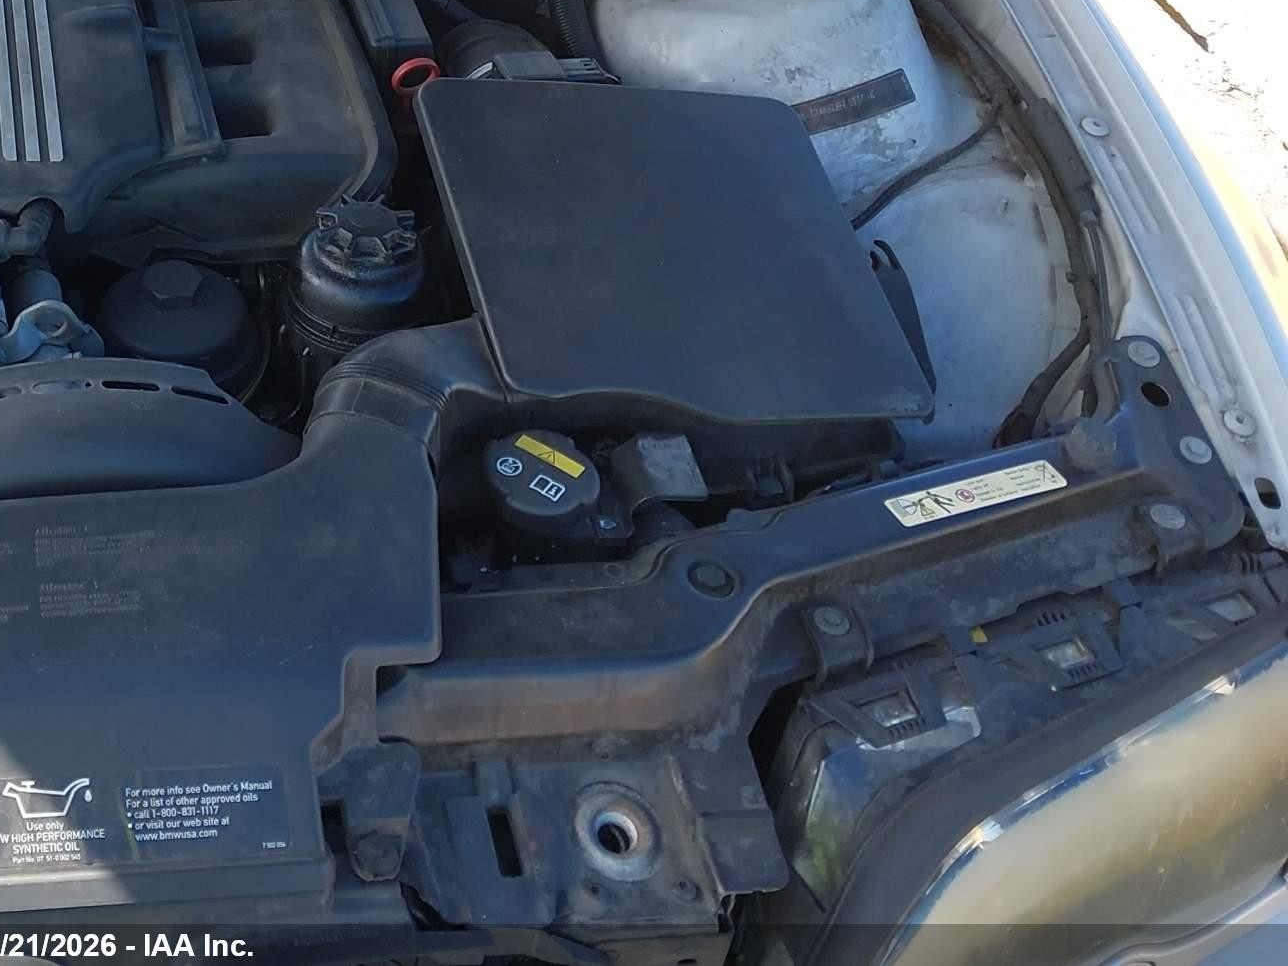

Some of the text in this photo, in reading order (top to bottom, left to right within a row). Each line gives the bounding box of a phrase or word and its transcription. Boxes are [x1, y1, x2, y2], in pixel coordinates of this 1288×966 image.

[125, 780, 273, 798] For more info see Owner's Manual
[126, 791, 258, 809] For a list of other approved oils
[134, 805, 219, 819] call 1-800-831-1117
[26, 820, 64, 832] Use only
[134, 815, 230, 830] or visit our web site at
[11, 832, 34, 844] HIGH
[35, 828, 106, 842] PERFORMANCE
[135, 828, 218, 842] www.bmwusa.com
[12, 841, 80, 855] SYNTHETIC OIL
